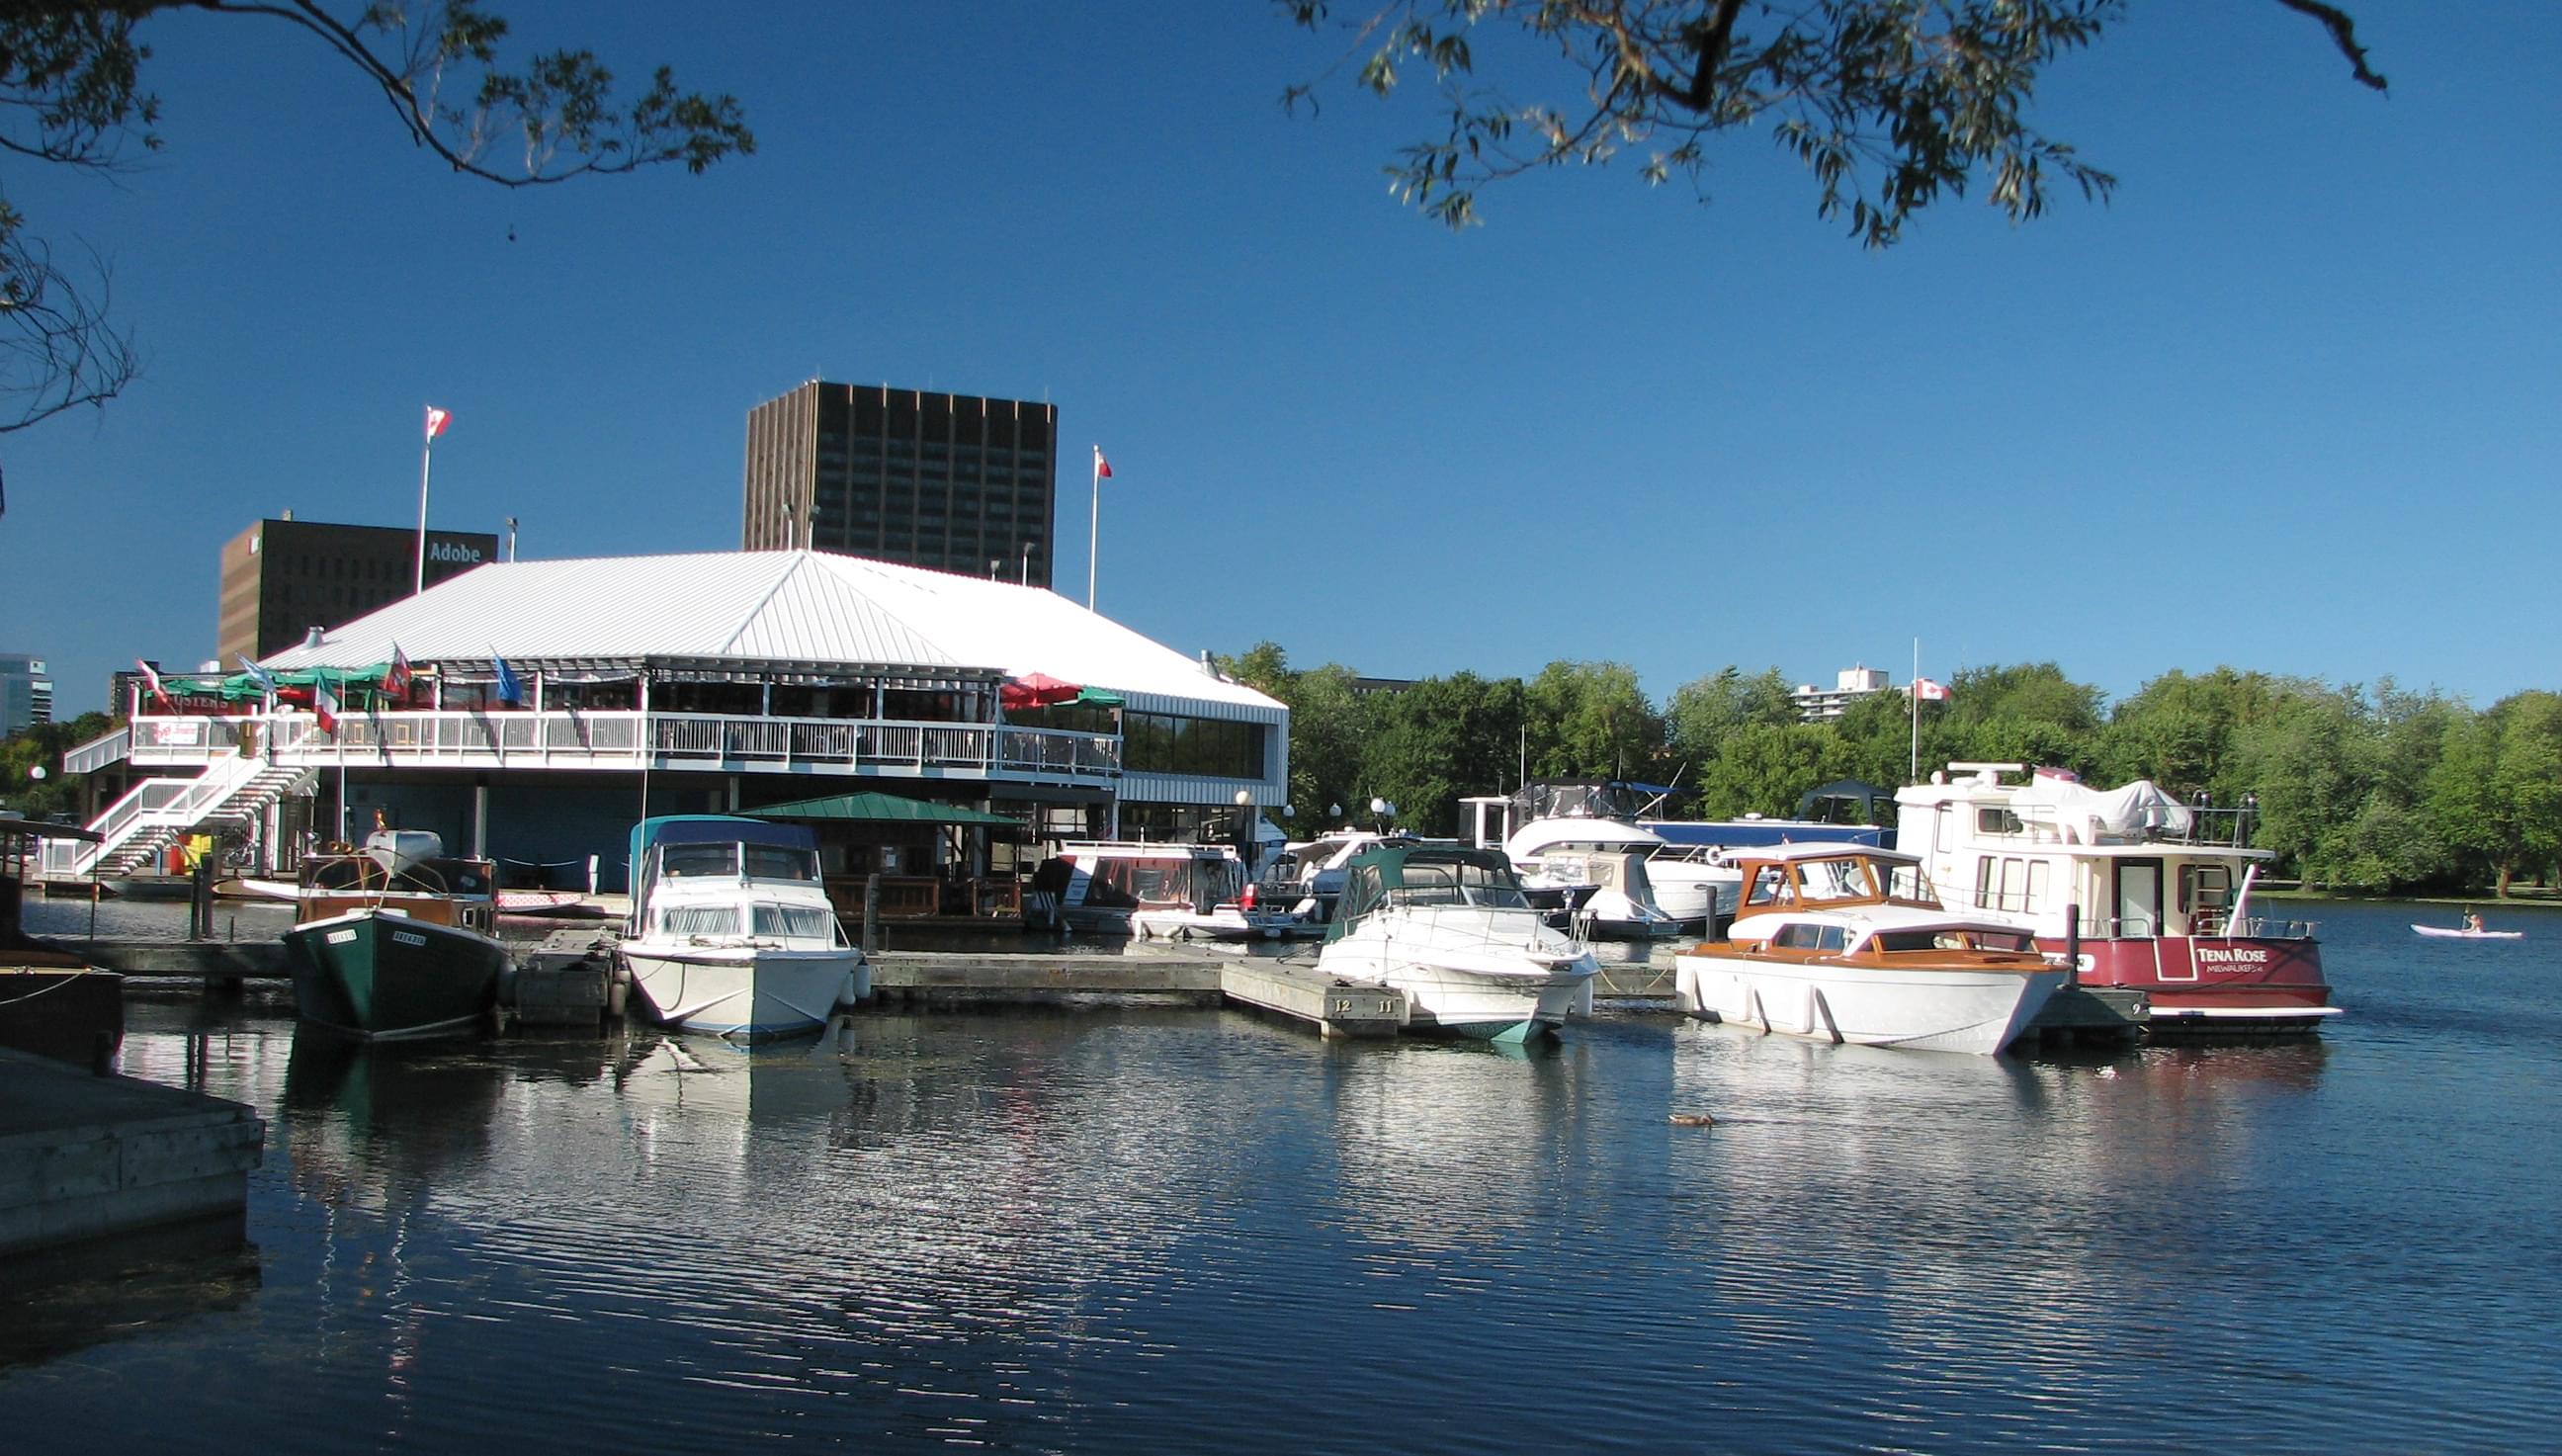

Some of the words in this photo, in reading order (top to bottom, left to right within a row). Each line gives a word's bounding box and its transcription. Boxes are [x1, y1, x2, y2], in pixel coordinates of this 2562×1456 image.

[430, 543, 480, 561] Adobe
[2196, 948, 2232, 962] TENA
[2234, 948, 2267, 962] ROSE
[1335, 999, 1351, 1012] 12
[1378, 999, 1392, 1013] 11
[2132, 1003, 2141, 1015] 9
